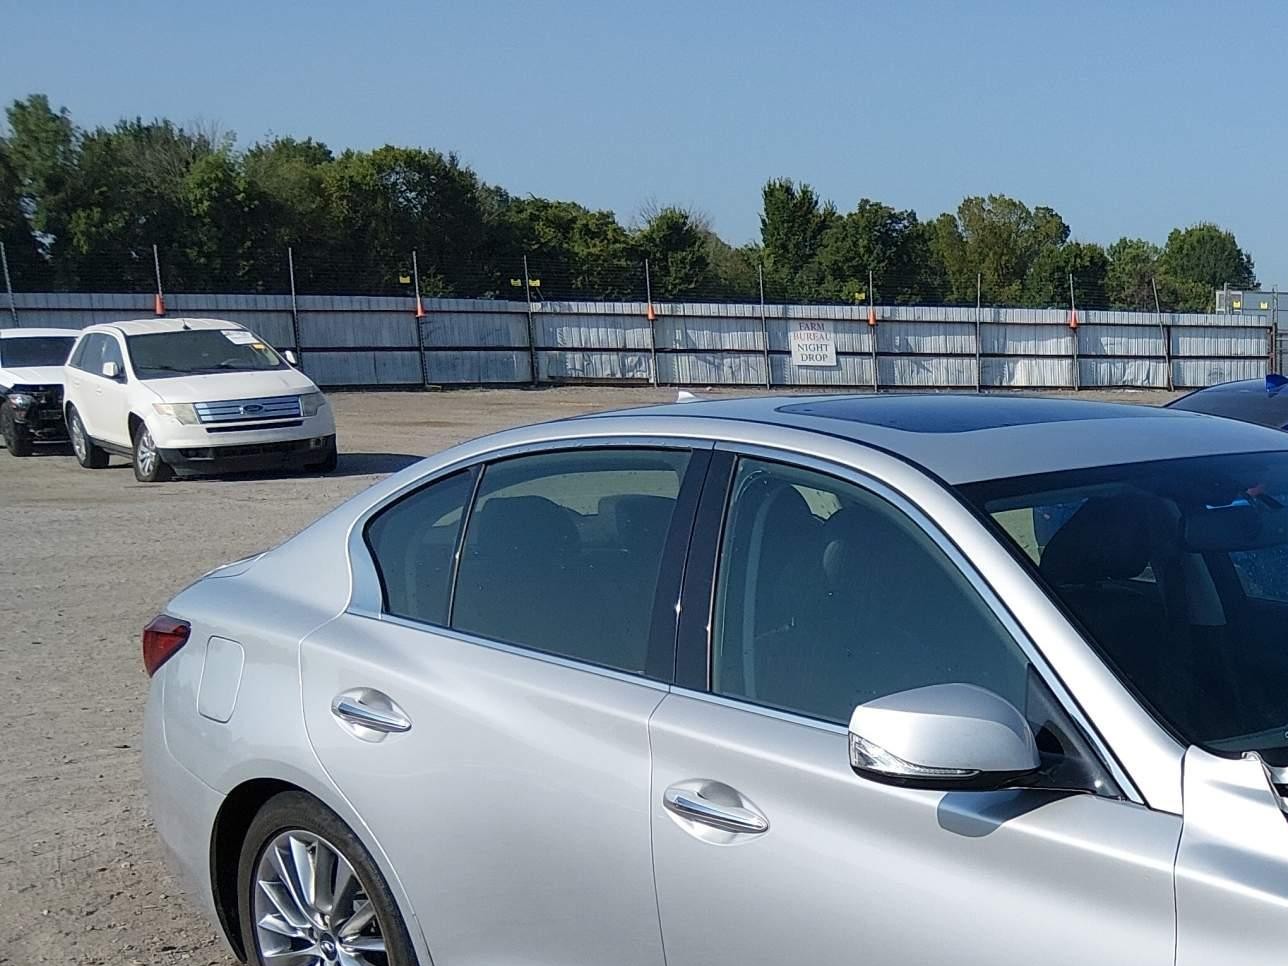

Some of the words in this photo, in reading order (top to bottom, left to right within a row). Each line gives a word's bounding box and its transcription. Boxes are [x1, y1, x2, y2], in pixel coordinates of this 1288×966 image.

[799, 322, 825, 331] FARM
[793, 332, 830, 341] BUREAU
[797, 343, 828, 352] NIGHT
[801, 353, 828, 362] DROP
